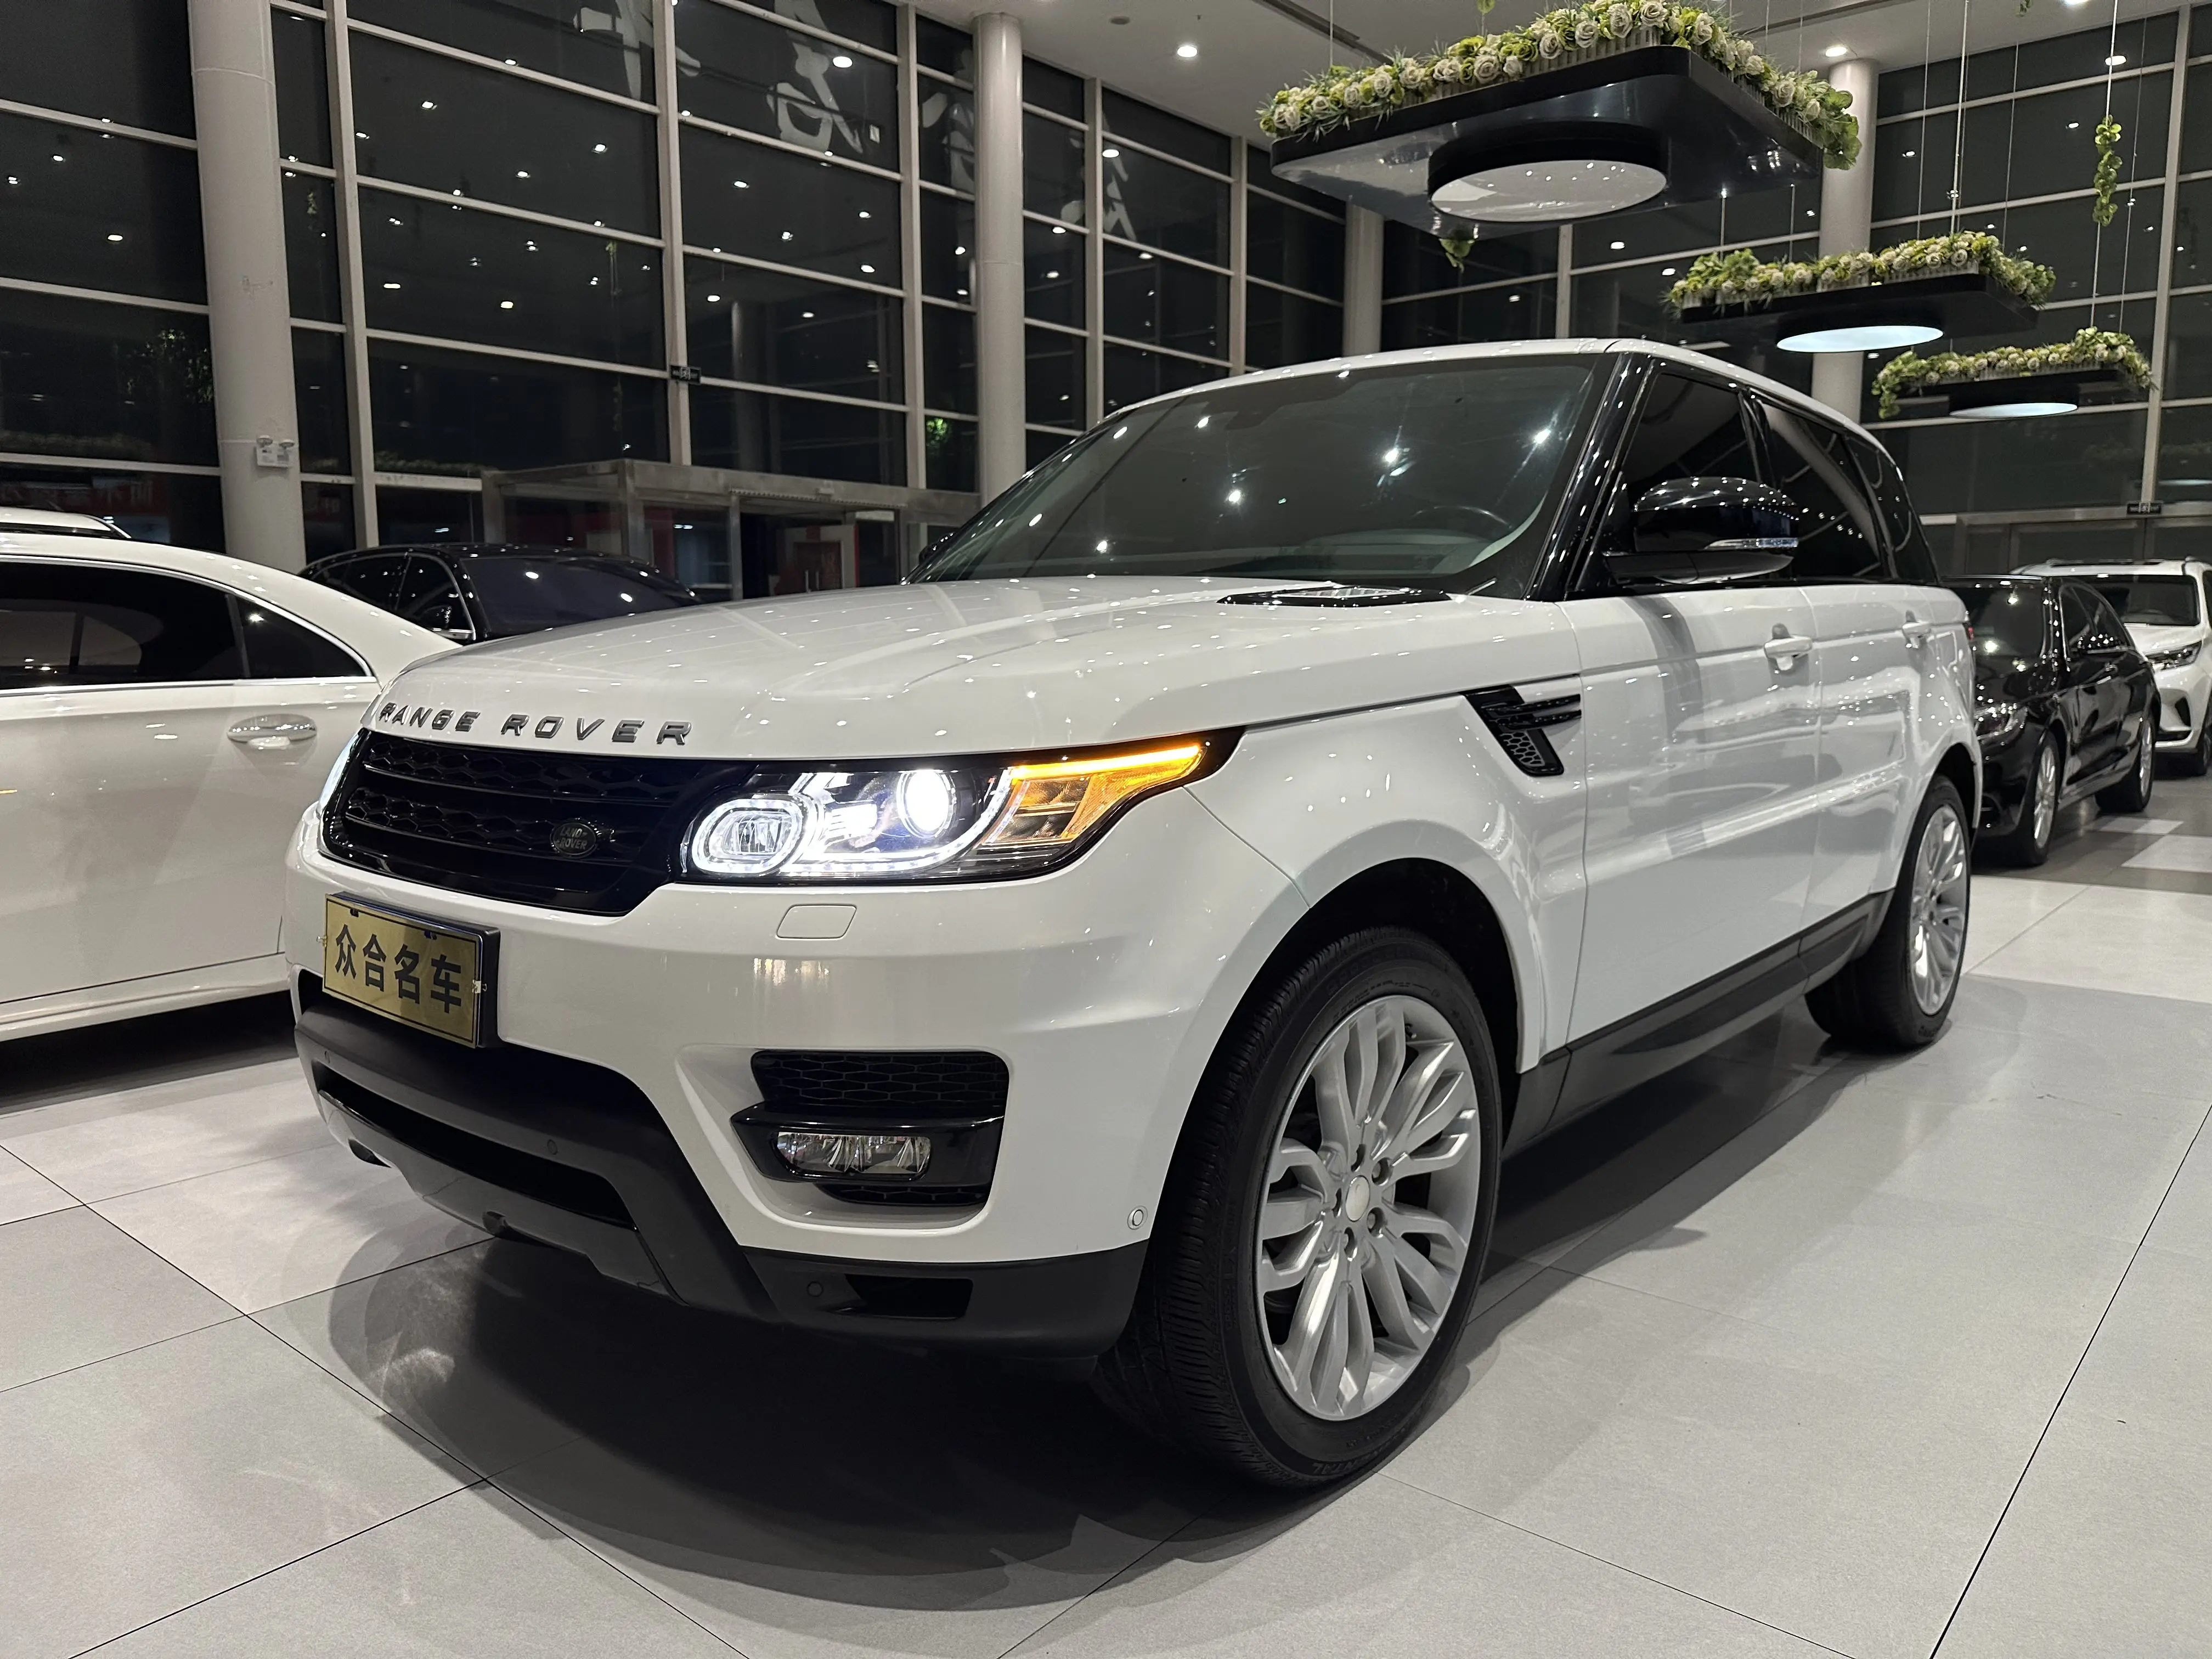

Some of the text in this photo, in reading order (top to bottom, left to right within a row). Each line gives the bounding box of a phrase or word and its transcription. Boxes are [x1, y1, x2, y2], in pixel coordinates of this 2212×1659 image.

[379, 702, 692, 746] RANGE ROVER
[559, 837, 588, 850] ROVER
[560, 826, 583, 838] LAND
[335, 924, 461, 1013] 众合名车
